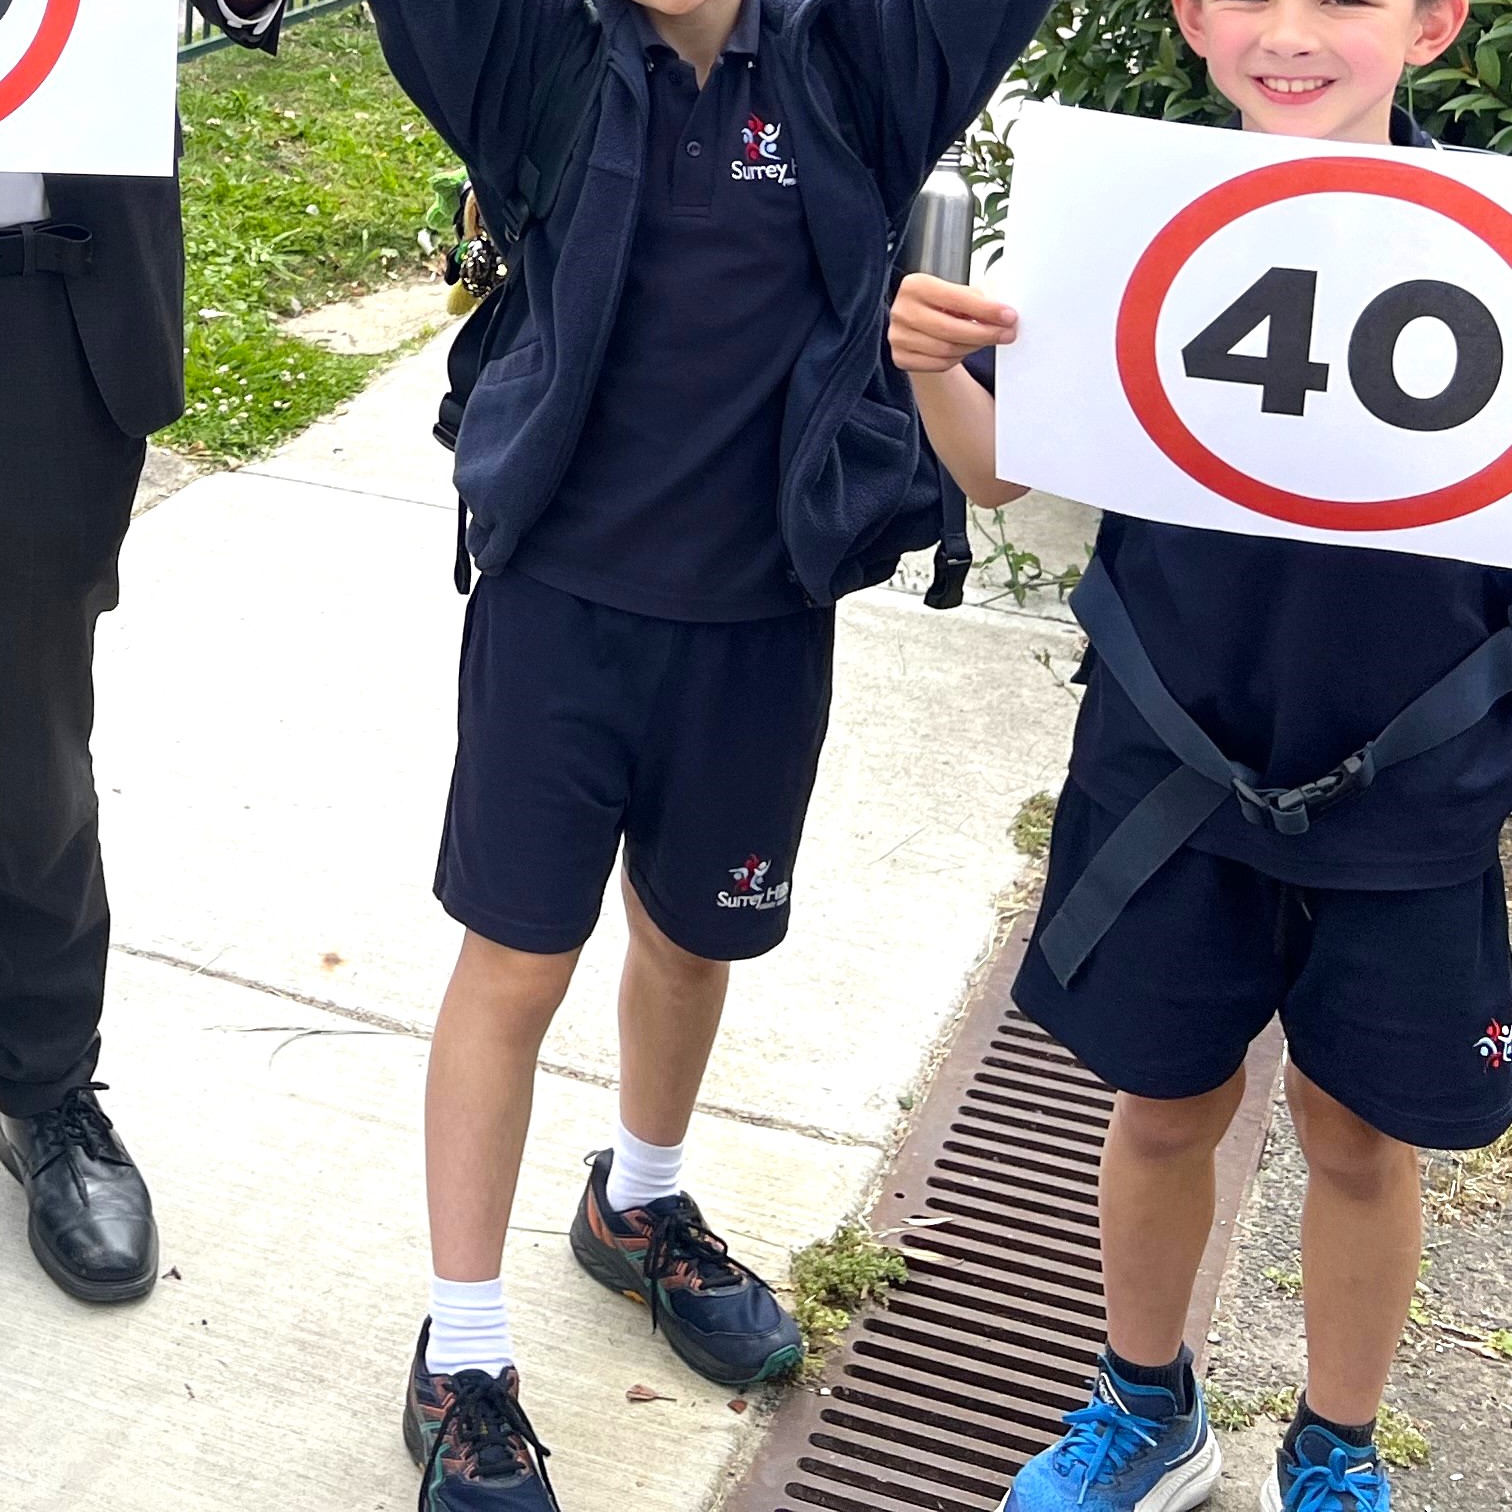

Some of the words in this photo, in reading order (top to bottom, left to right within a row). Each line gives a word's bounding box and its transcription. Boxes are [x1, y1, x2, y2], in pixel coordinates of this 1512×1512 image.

[731, 160, 788, 184] Surrey
[1182, 268, 1503, 431] 40
[716, 891, 765, 909] Surrey
